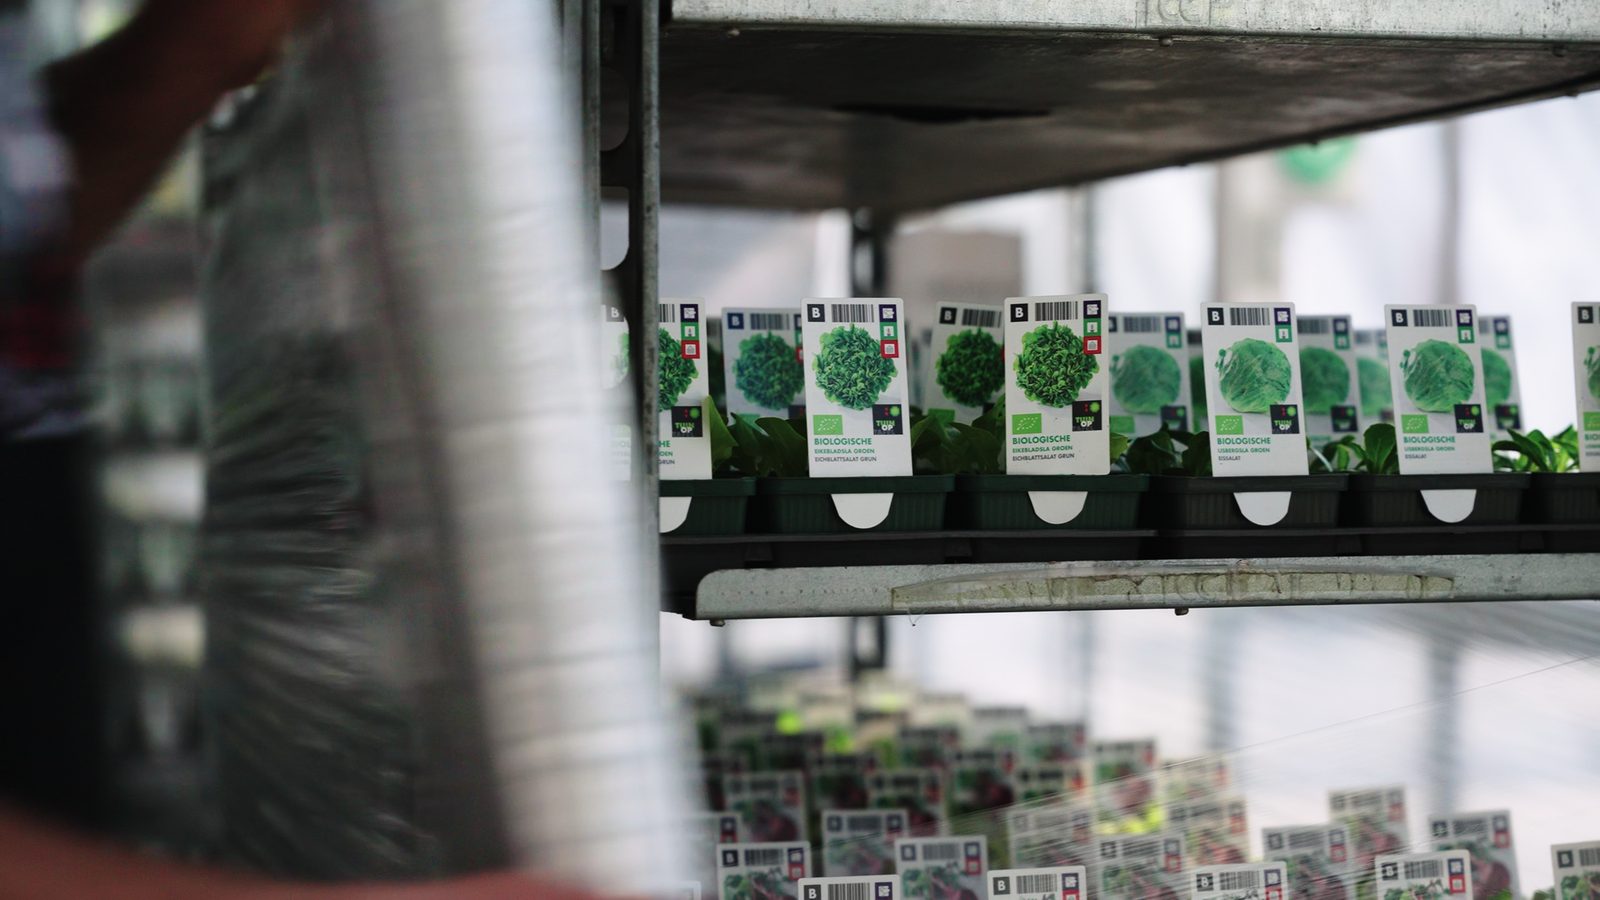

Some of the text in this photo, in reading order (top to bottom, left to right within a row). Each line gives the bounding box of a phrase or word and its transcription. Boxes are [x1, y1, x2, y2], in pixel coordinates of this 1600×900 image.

[814, 437, 872, 446] BIOLOGISCHE
[1012, 434, 1071, 445] BIOLOGISCHE
[1216, 437, 1271, 445] BIOLOGISCHE
[1403, 436, 1456, 444] BIOLOGISCHE
[1012, 446, 1050, 454] EIKEBLADSLA
